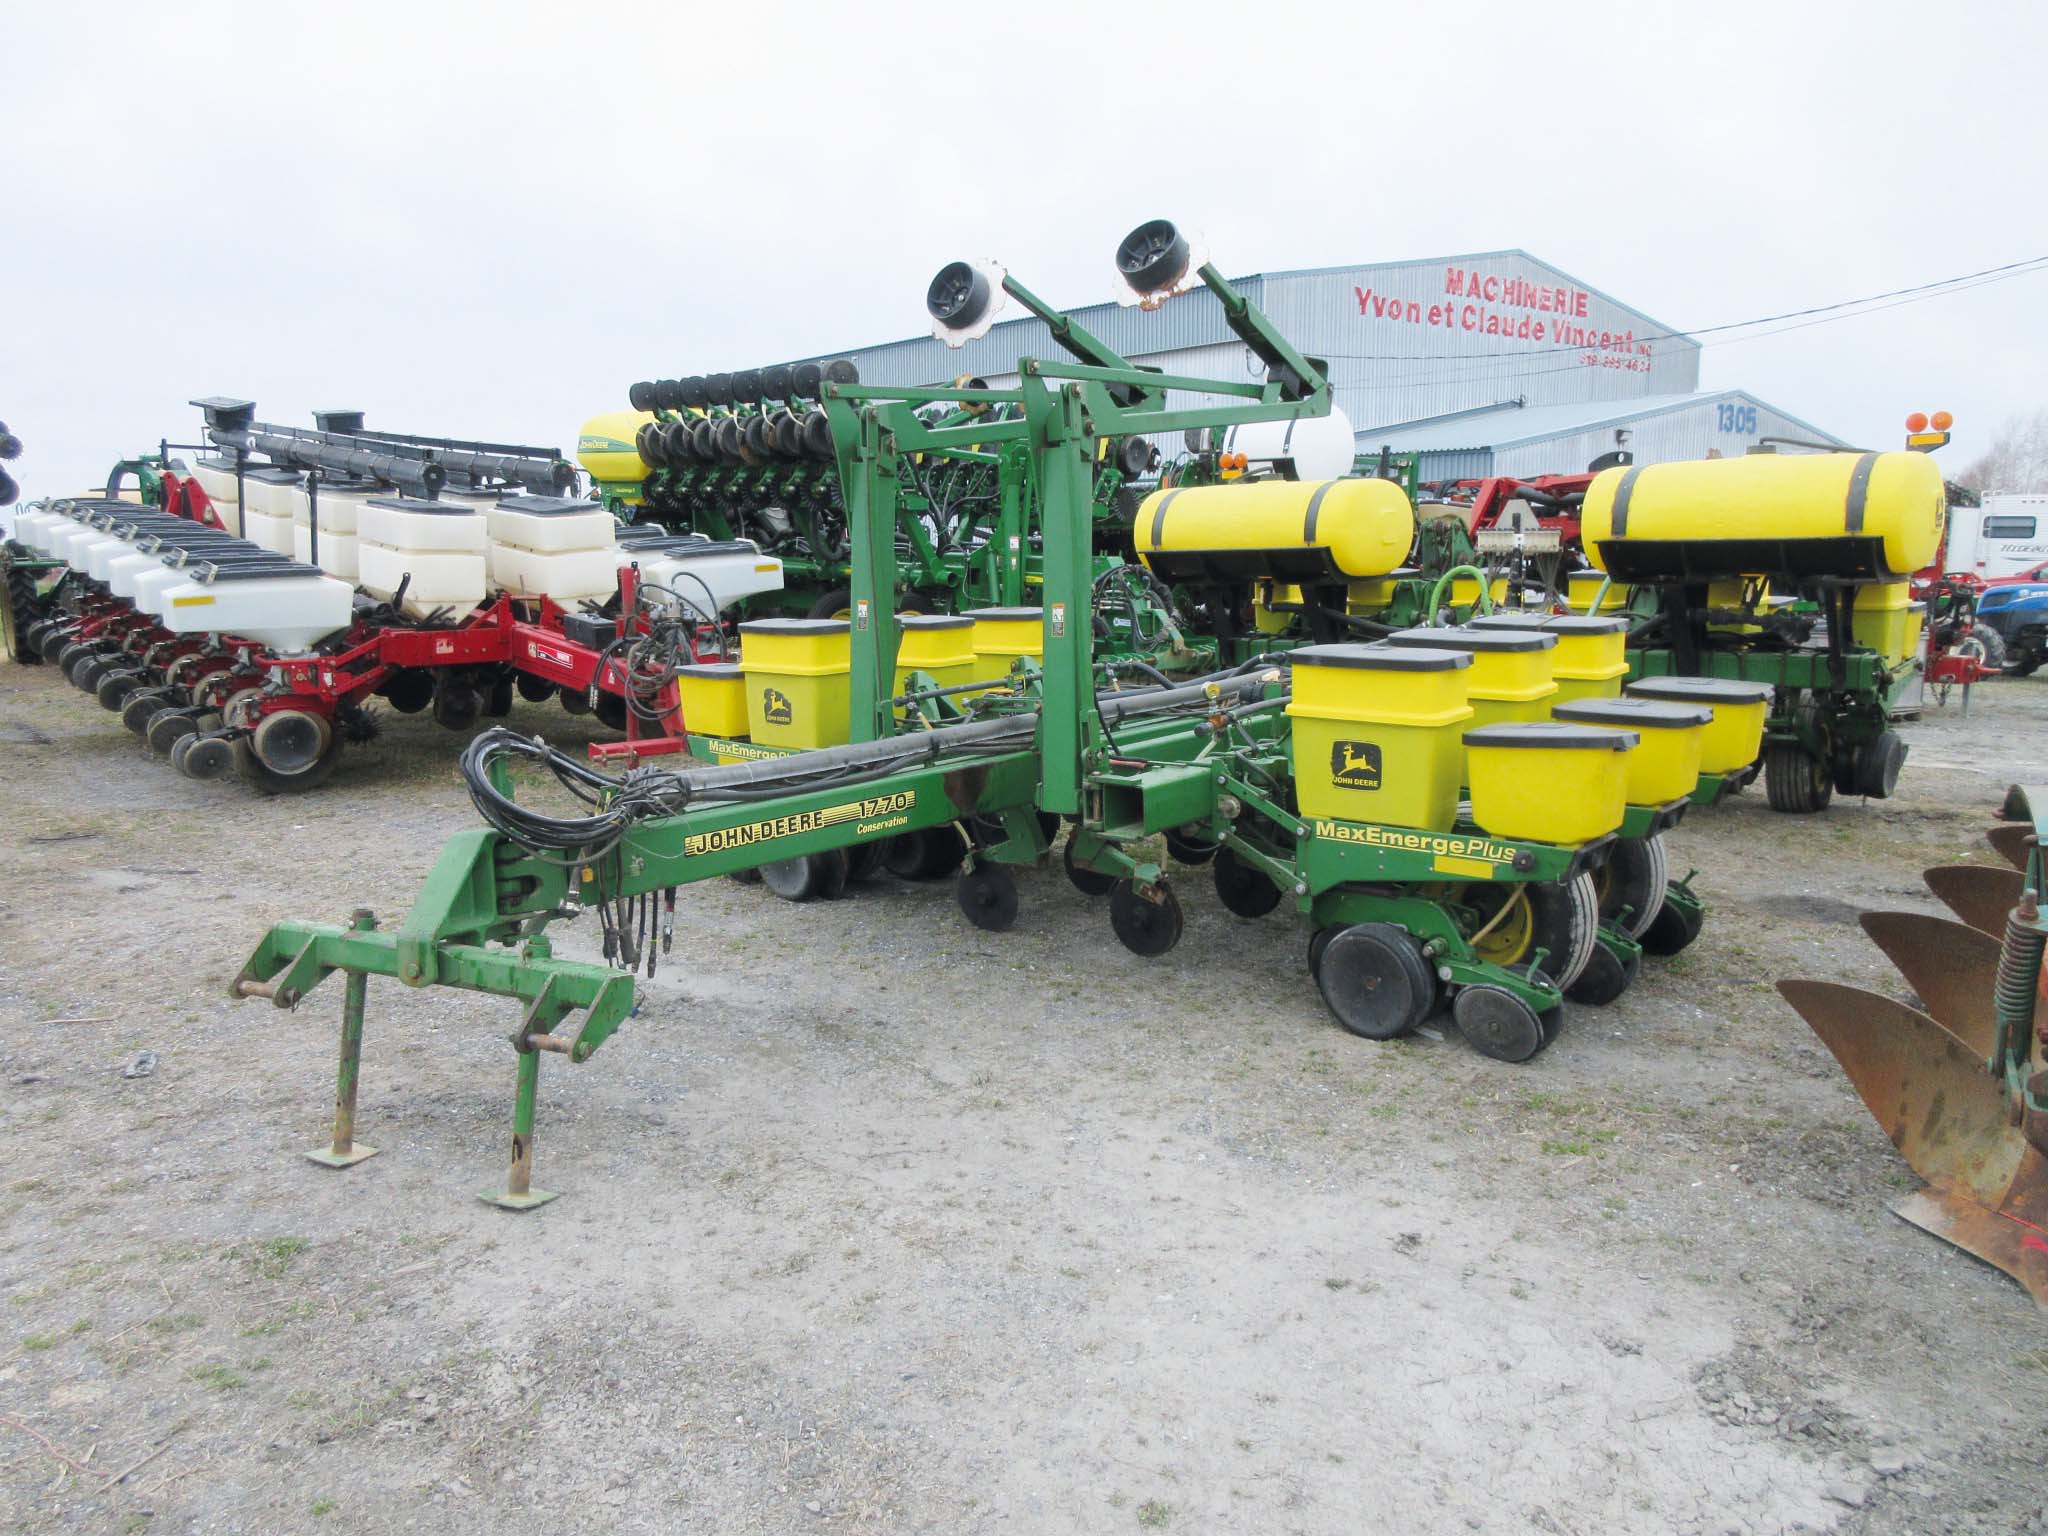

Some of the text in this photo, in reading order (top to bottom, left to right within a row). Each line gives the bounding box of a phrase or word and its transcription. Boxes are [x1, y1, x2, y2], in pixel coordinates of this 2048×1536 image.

[1445, 267, 1589, 318] MACHINERIE
[1354, 286, 1420, 324] Yvon
[1427, 301, 1454, 329] et
[1461, 304, 1545, 341] Claude
[1552, 318, 1633, 353] Vincent
[1717, 403, 1757, 434] 1305
[1333, 776, 1379, 787] JOHN DEERE
[696, 793, 908, 853] JOHN DEERE 1770
[857, 815, 908, 834] Conservation
